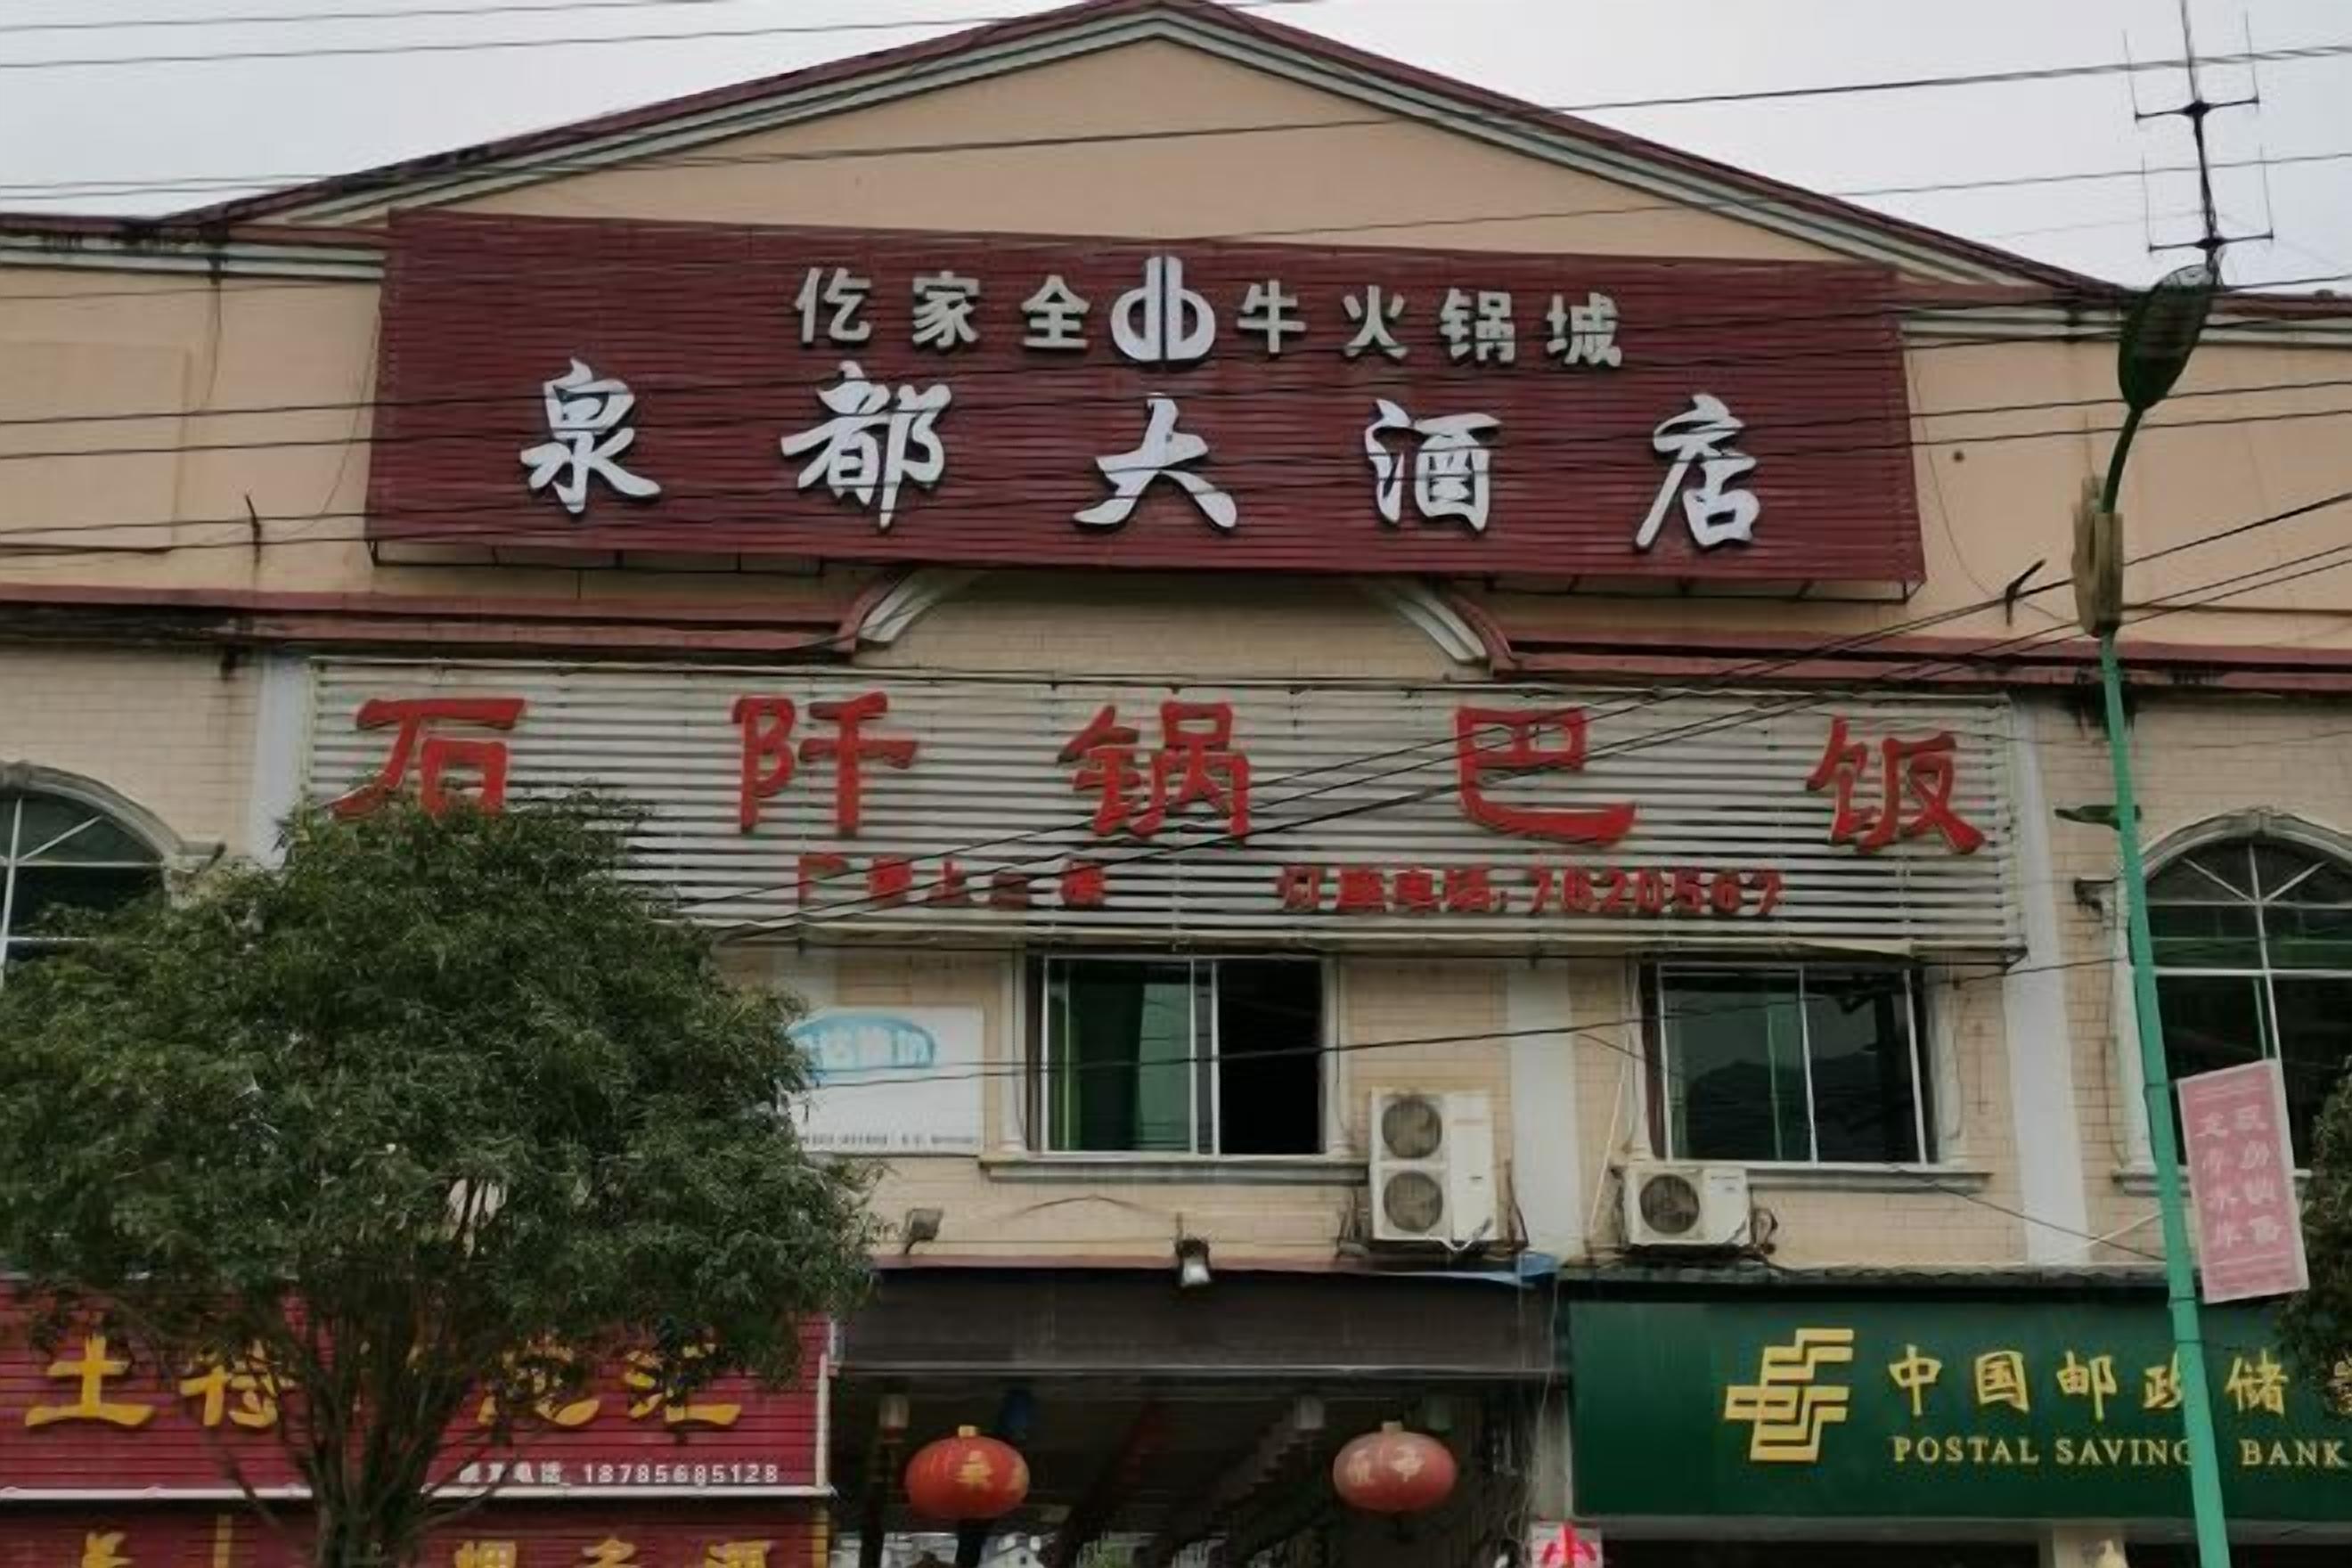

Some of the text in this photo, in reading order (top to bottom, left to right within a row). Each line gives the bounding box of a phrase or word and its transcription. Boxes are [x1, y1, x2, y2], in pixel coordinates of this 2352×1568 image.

[519, 357, 1760, 548] 泉都大酒店
[332, 693, 1987, 855] 石阡锅巴饭
[1891, 1435, 2350, 1468] POSTAL SAVING BANK
